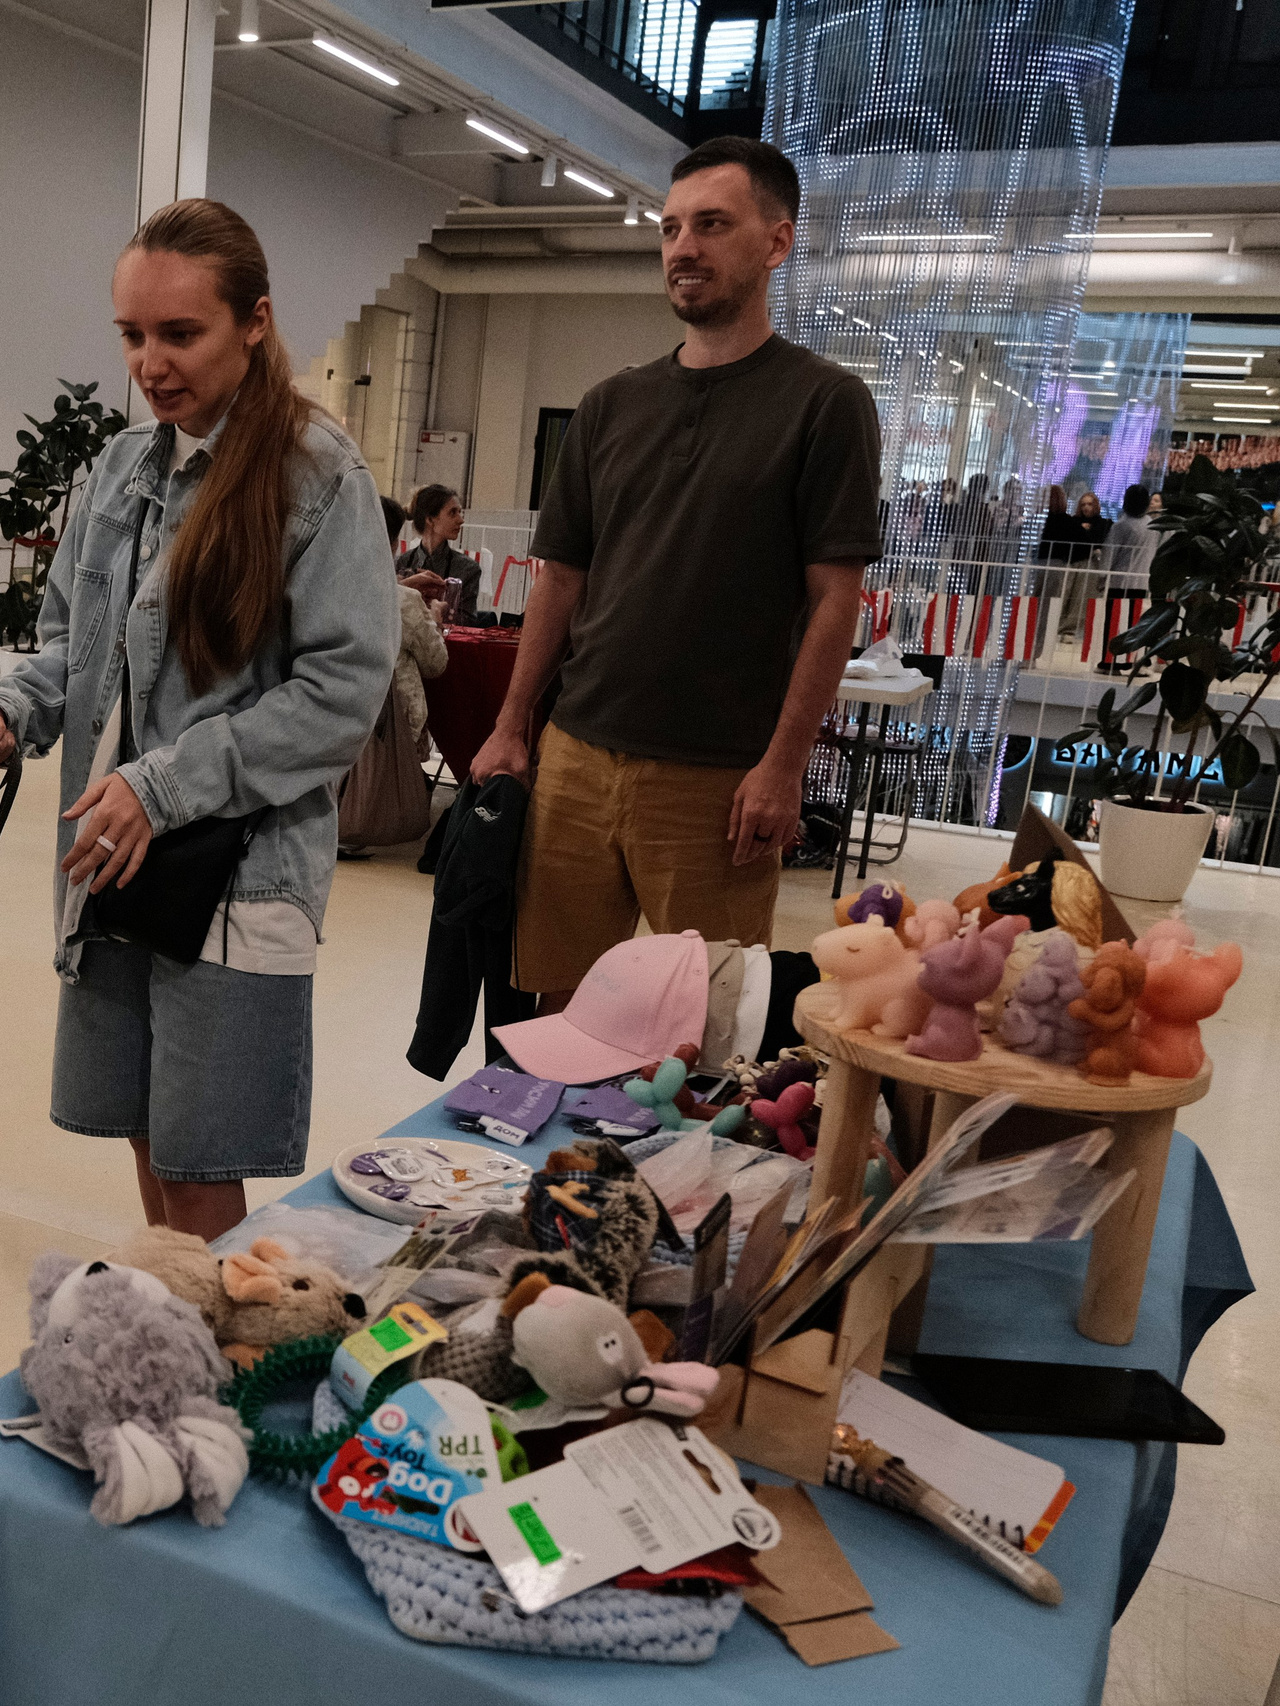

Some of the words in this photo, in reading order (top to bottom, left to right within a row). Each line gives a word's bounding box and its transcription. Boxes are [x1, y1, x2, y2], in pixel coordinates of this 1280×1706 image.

[380, 1442, 426, 1470] Toys
[439, 1434, 484, 1456] TPR
[385, 1460, 453, 1505] Dog
